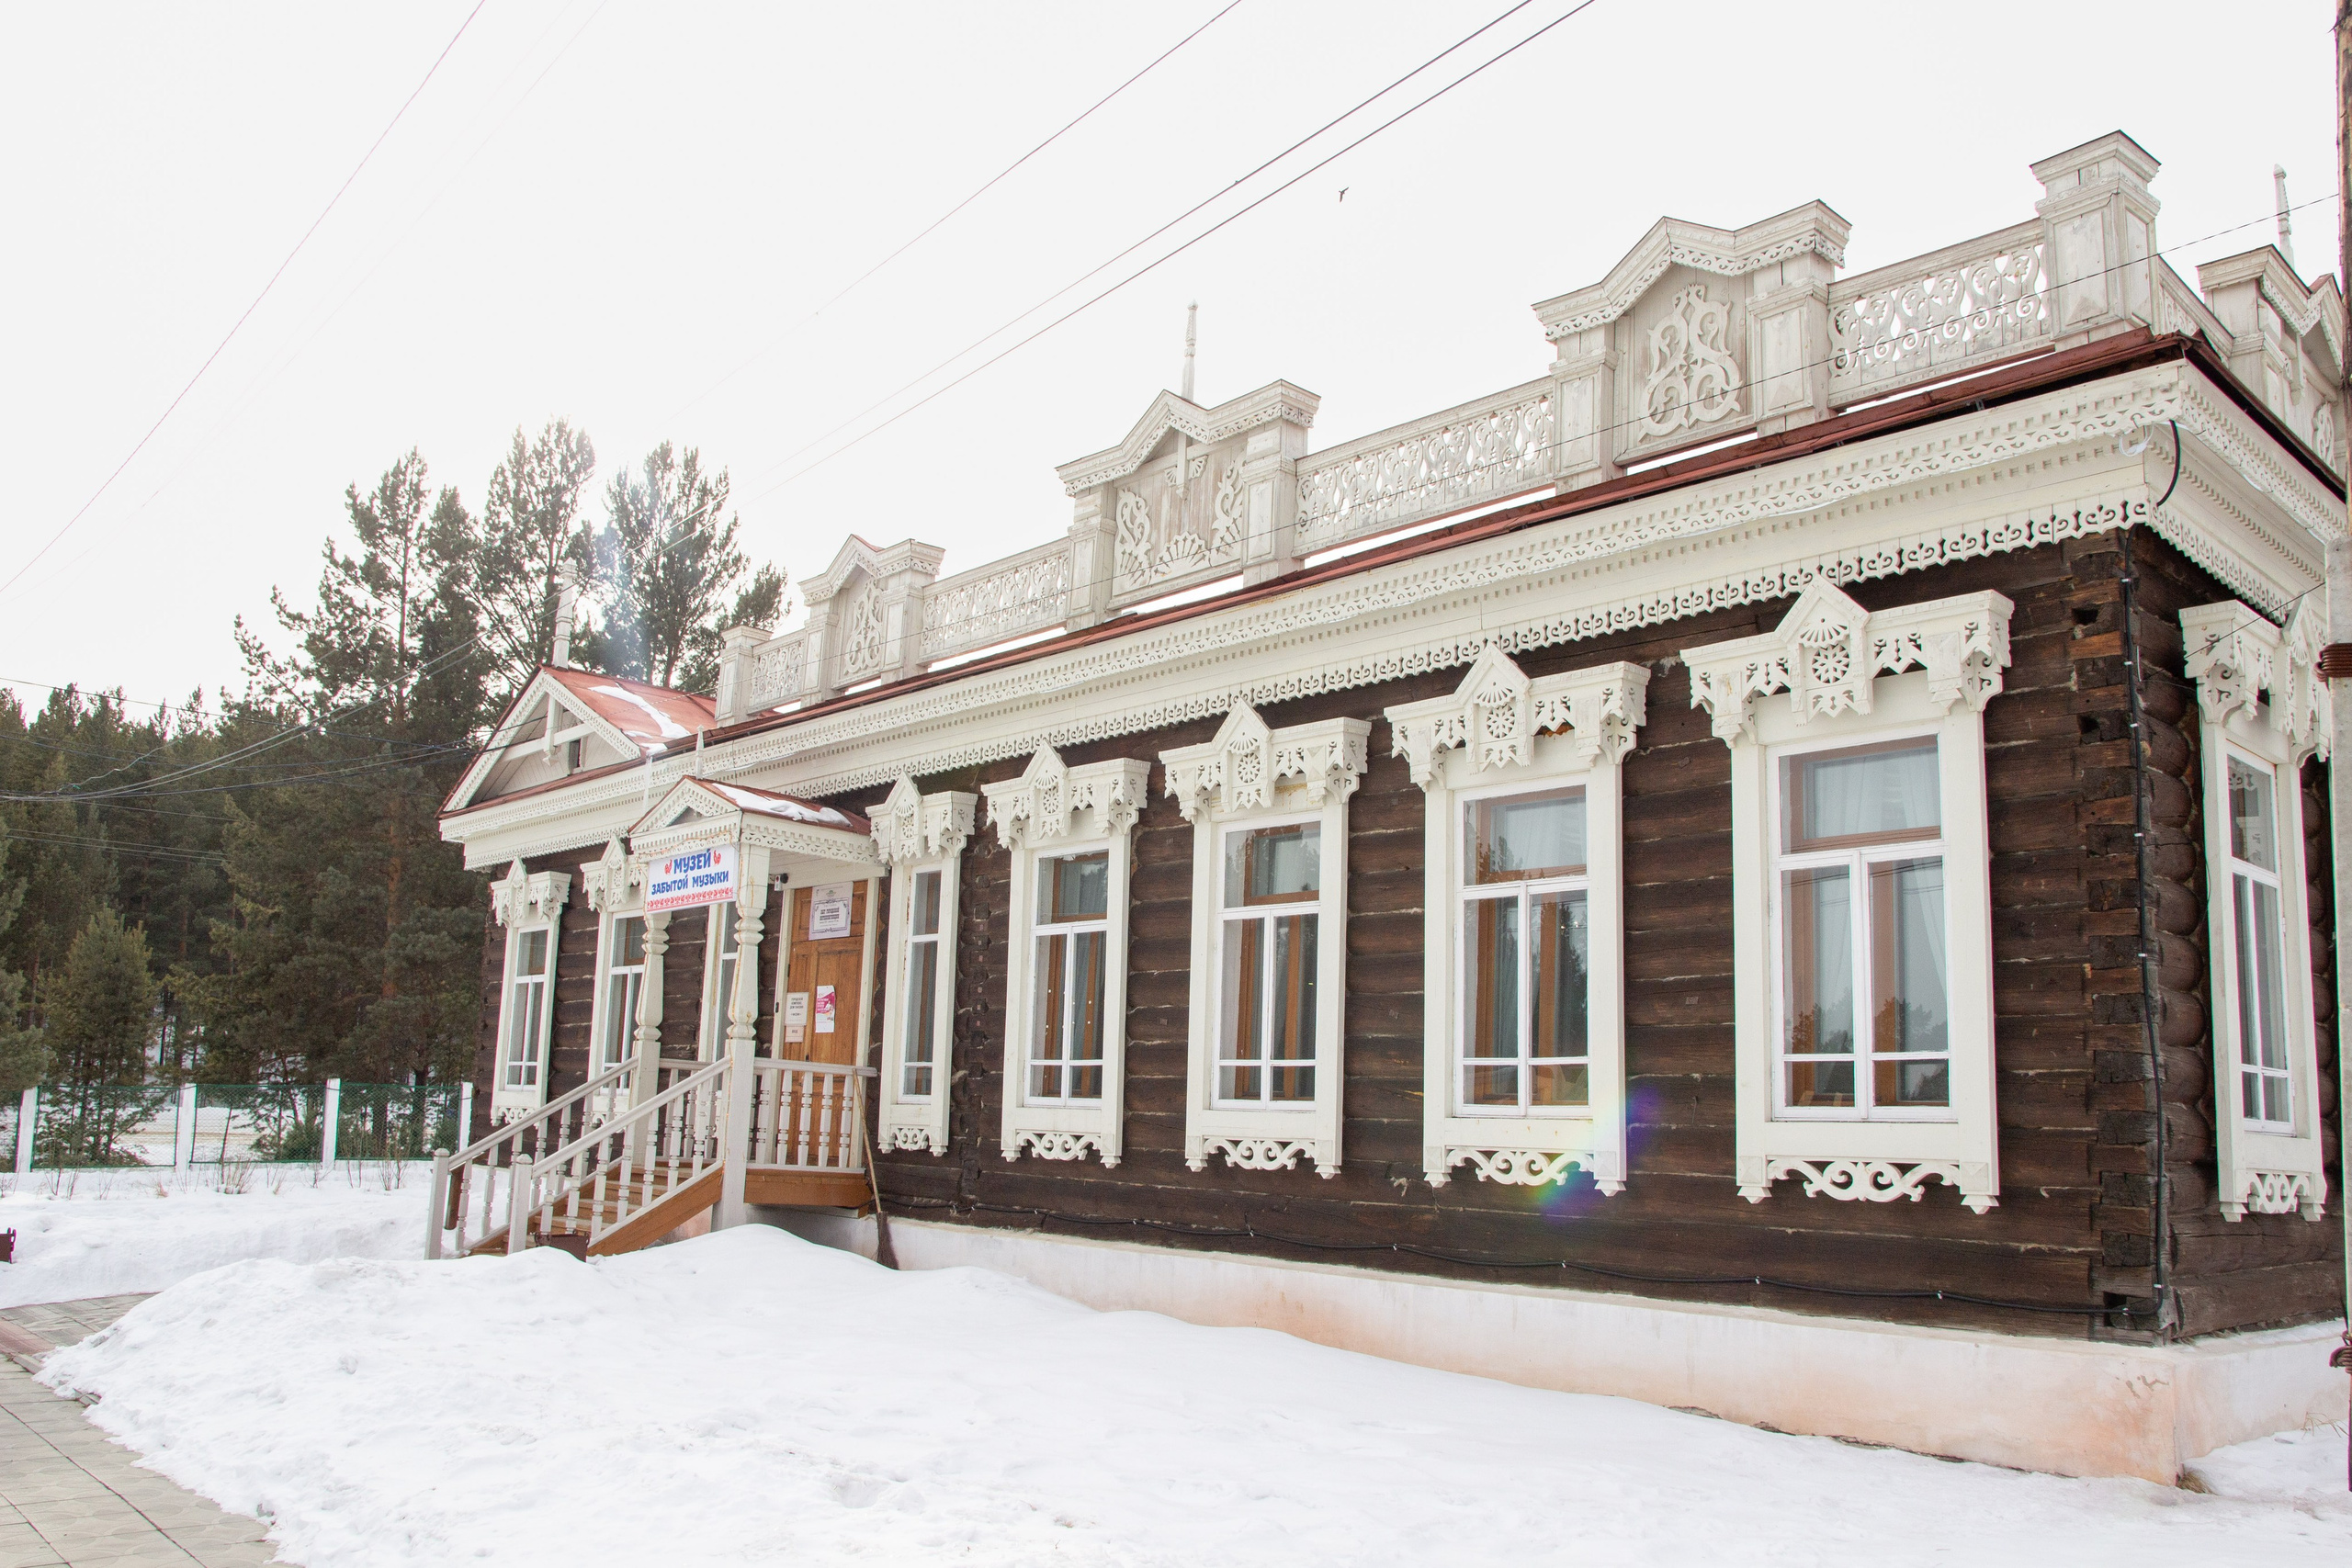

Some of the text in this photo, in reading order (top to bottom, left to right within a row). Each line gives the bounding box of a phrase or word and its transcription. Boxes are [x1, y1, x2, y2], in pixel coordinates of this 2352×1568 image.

[673, 848, 711, 874] МУЗЕЙ
[651, 870, 729, 895] ЗАБЫТОЙ МУЗЫКИ
